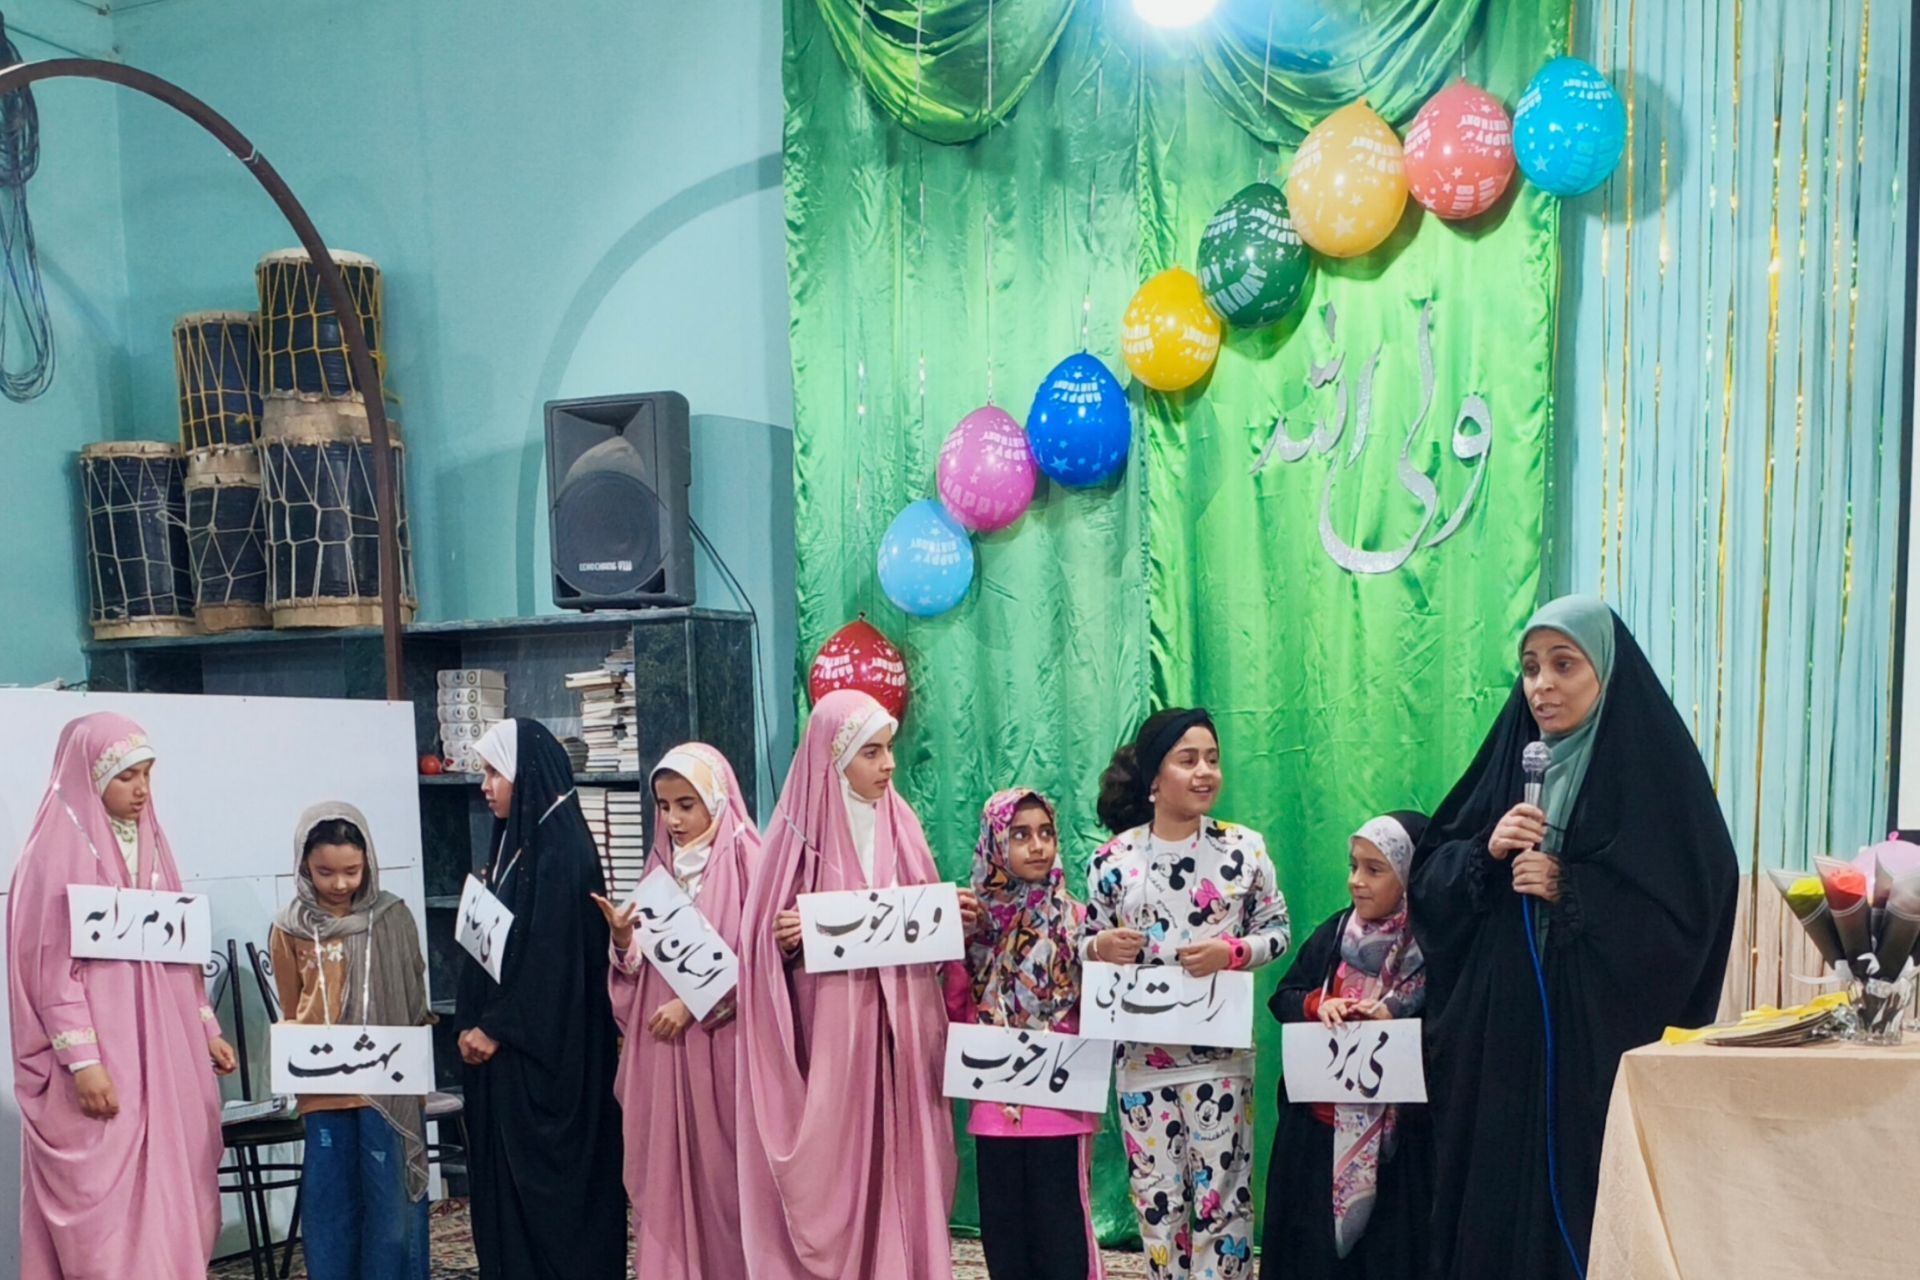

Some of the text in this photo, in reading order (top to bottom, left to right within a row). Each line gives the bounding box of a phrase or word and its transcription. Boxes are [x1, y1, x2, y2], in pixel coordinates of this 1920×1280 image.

[1053, 380, 1098, 392] BIRTHDAY
[1062, 391, 1102, 404] HAPPY
[83, 890, 197, 956] آدم را به
[634, 904, 728, 991] انسان را به
[815, 886, 942, 959] و کار خوب
[287, 1033, 403, 1083] بهشت
[961, 1031, 1088, 1094] کار خوب
[1357, 1030, 1390, 1099] می
